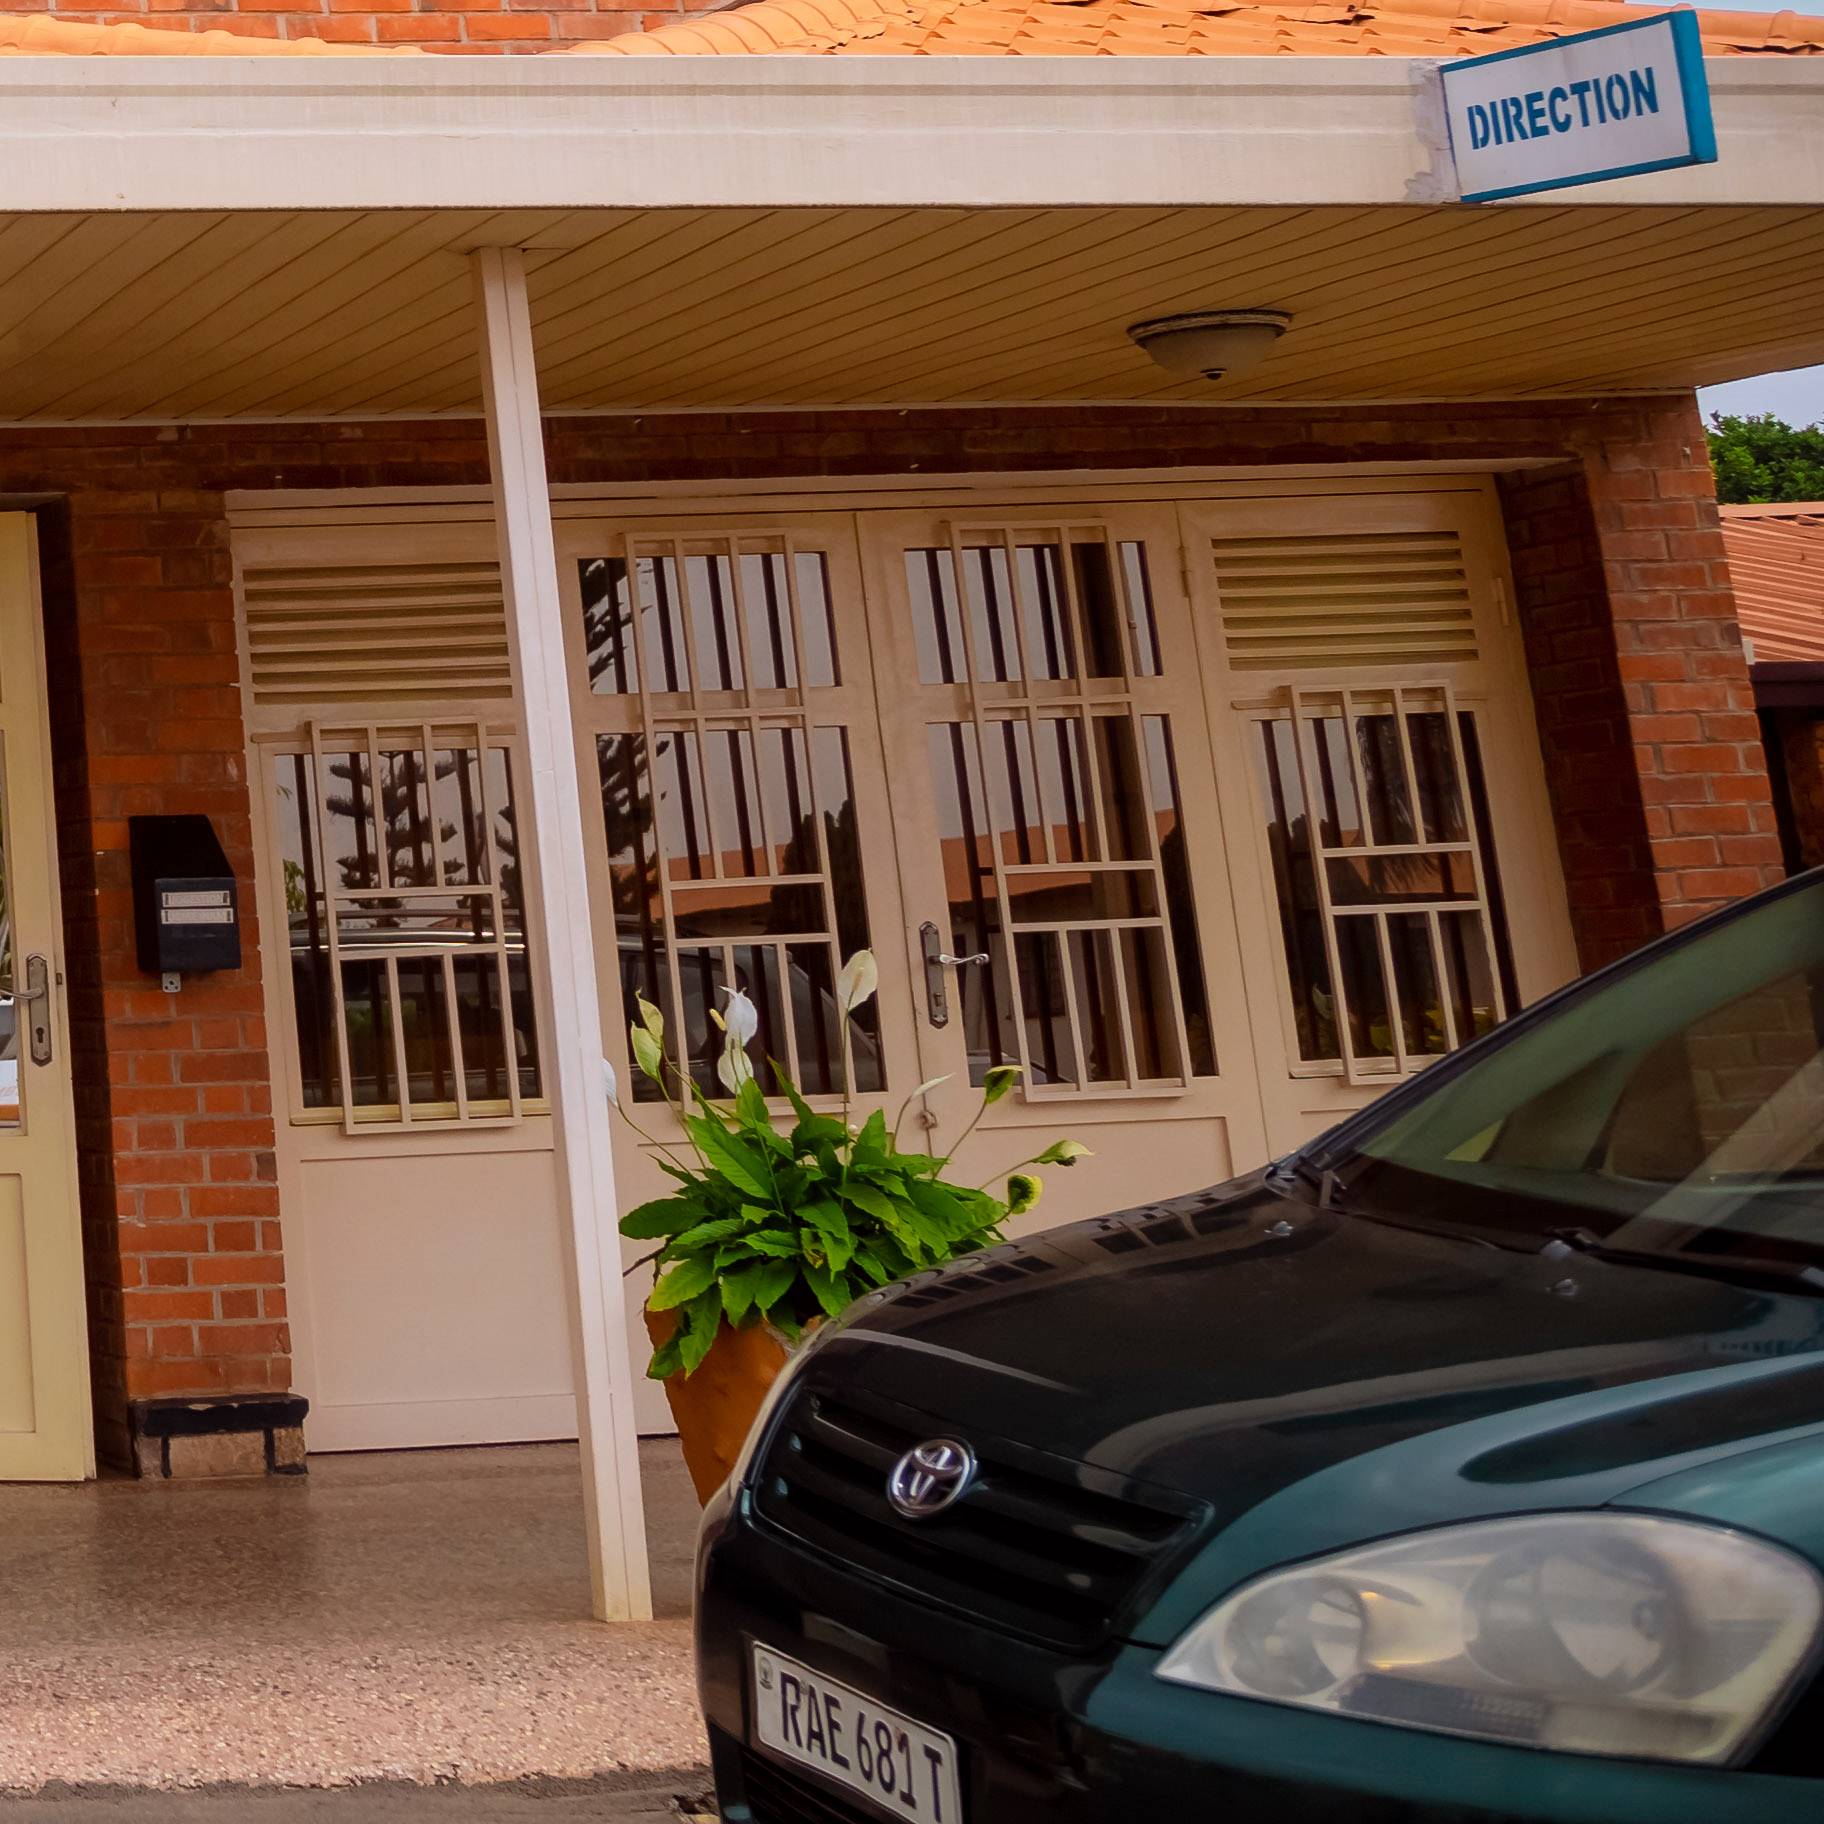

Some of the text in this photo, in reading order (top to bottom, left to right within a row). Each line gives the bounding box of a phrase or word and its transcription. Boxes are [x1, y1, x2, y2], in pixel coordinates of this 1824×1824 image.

[1467, 67, 1659, 150] DIRECTION
[780, 1671, 942, 1824] RAE 681 T
